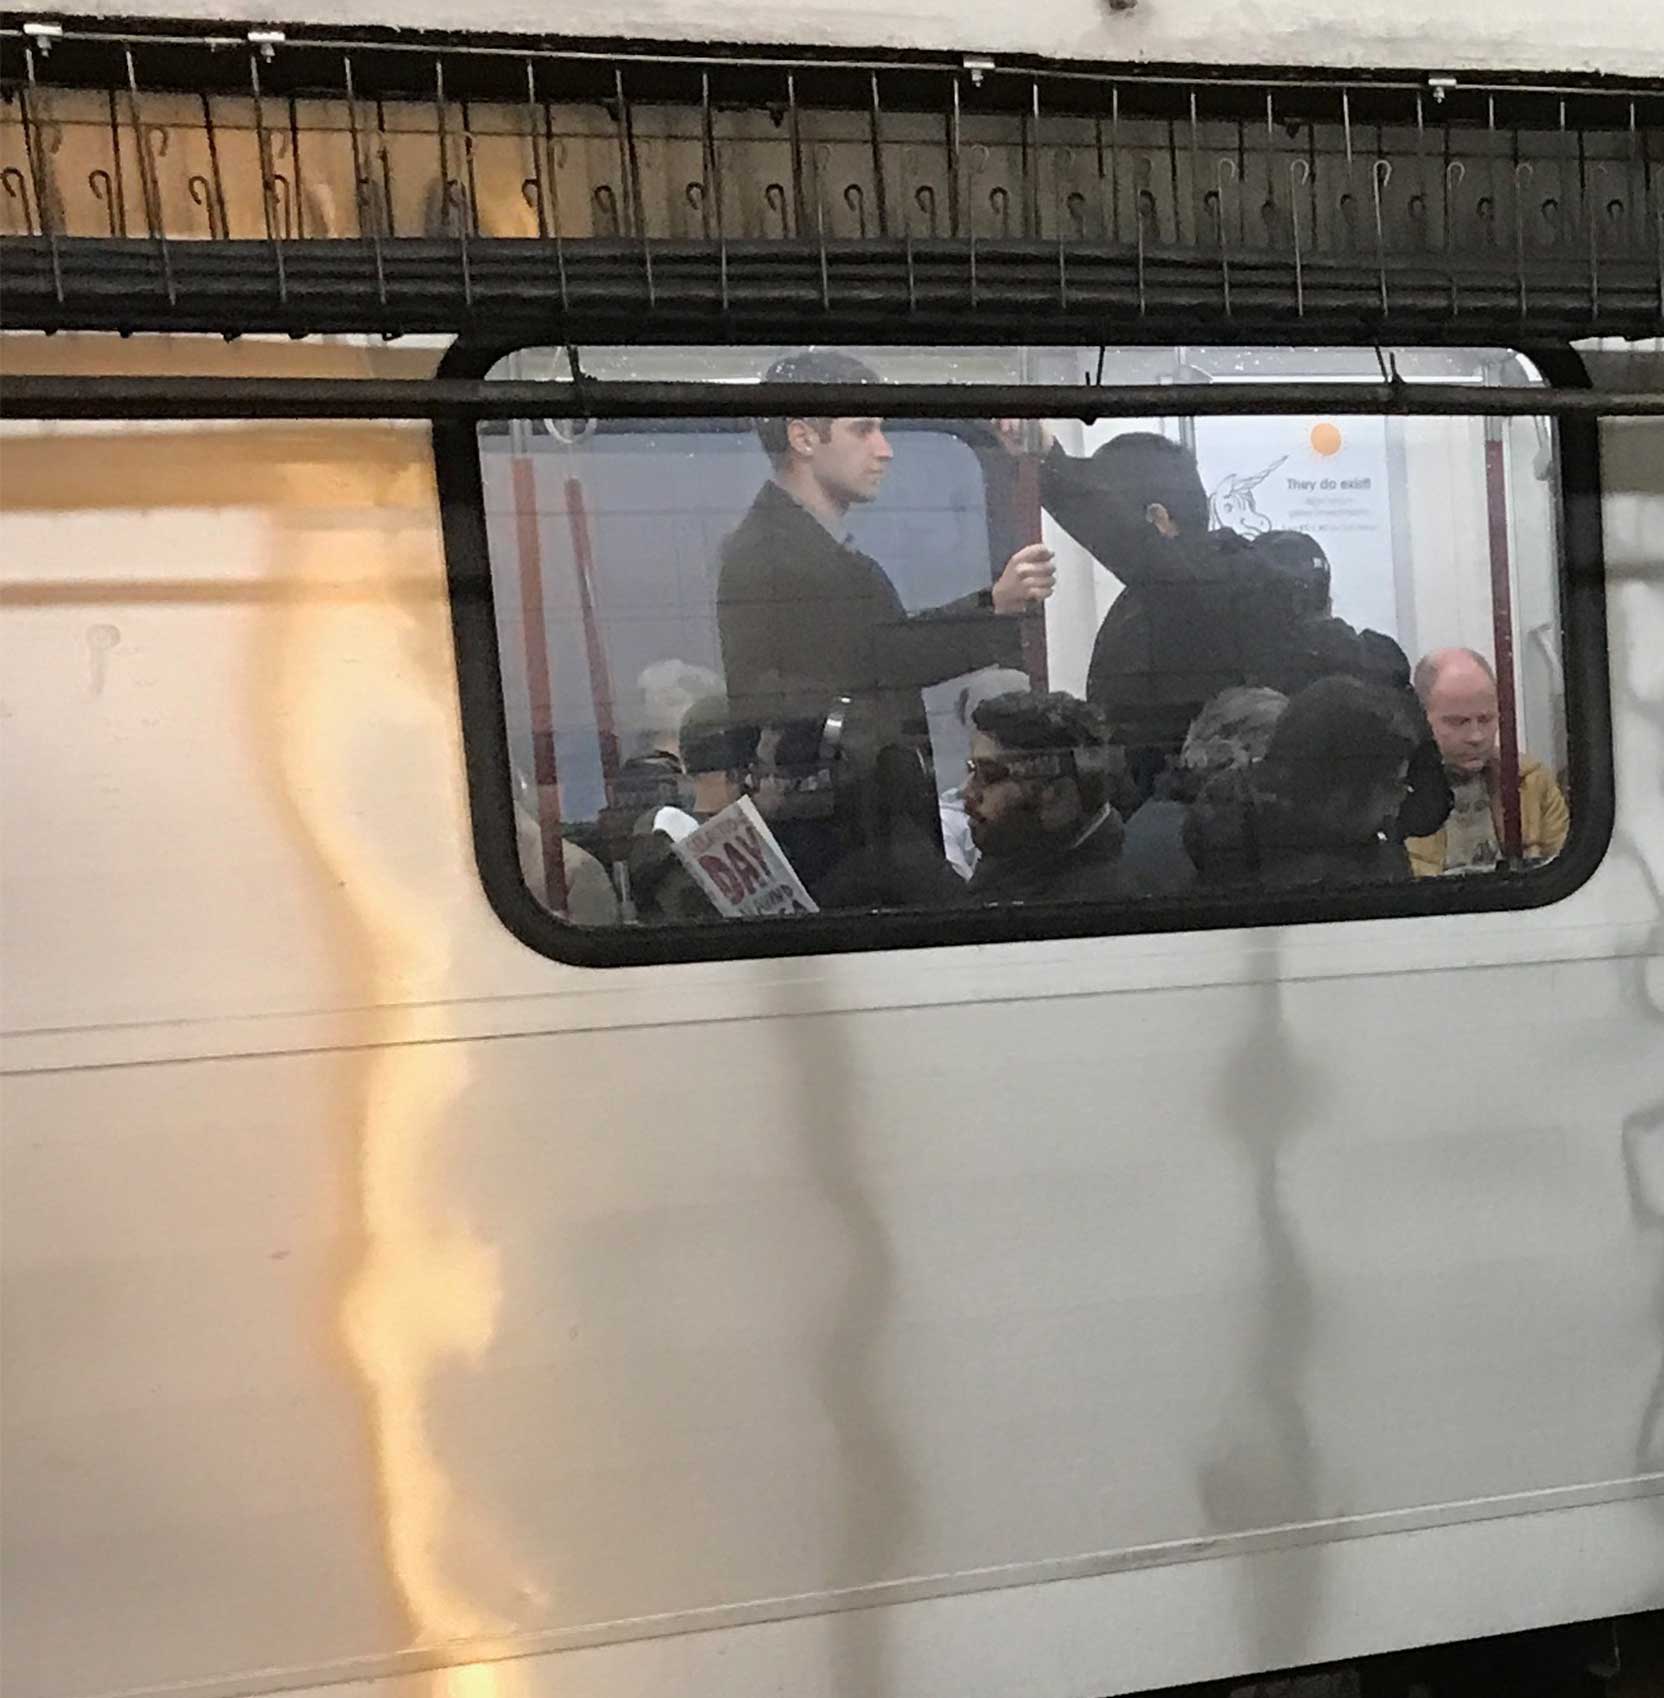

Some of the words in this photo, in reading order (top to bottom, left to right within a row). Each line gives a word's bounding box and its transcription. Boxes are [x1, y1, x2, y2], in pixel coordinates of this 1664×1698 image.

[1287, 479, 1316, 492] They
[1320, 478, 1336, 490] do
[698, 826, 772, 906] DAY
